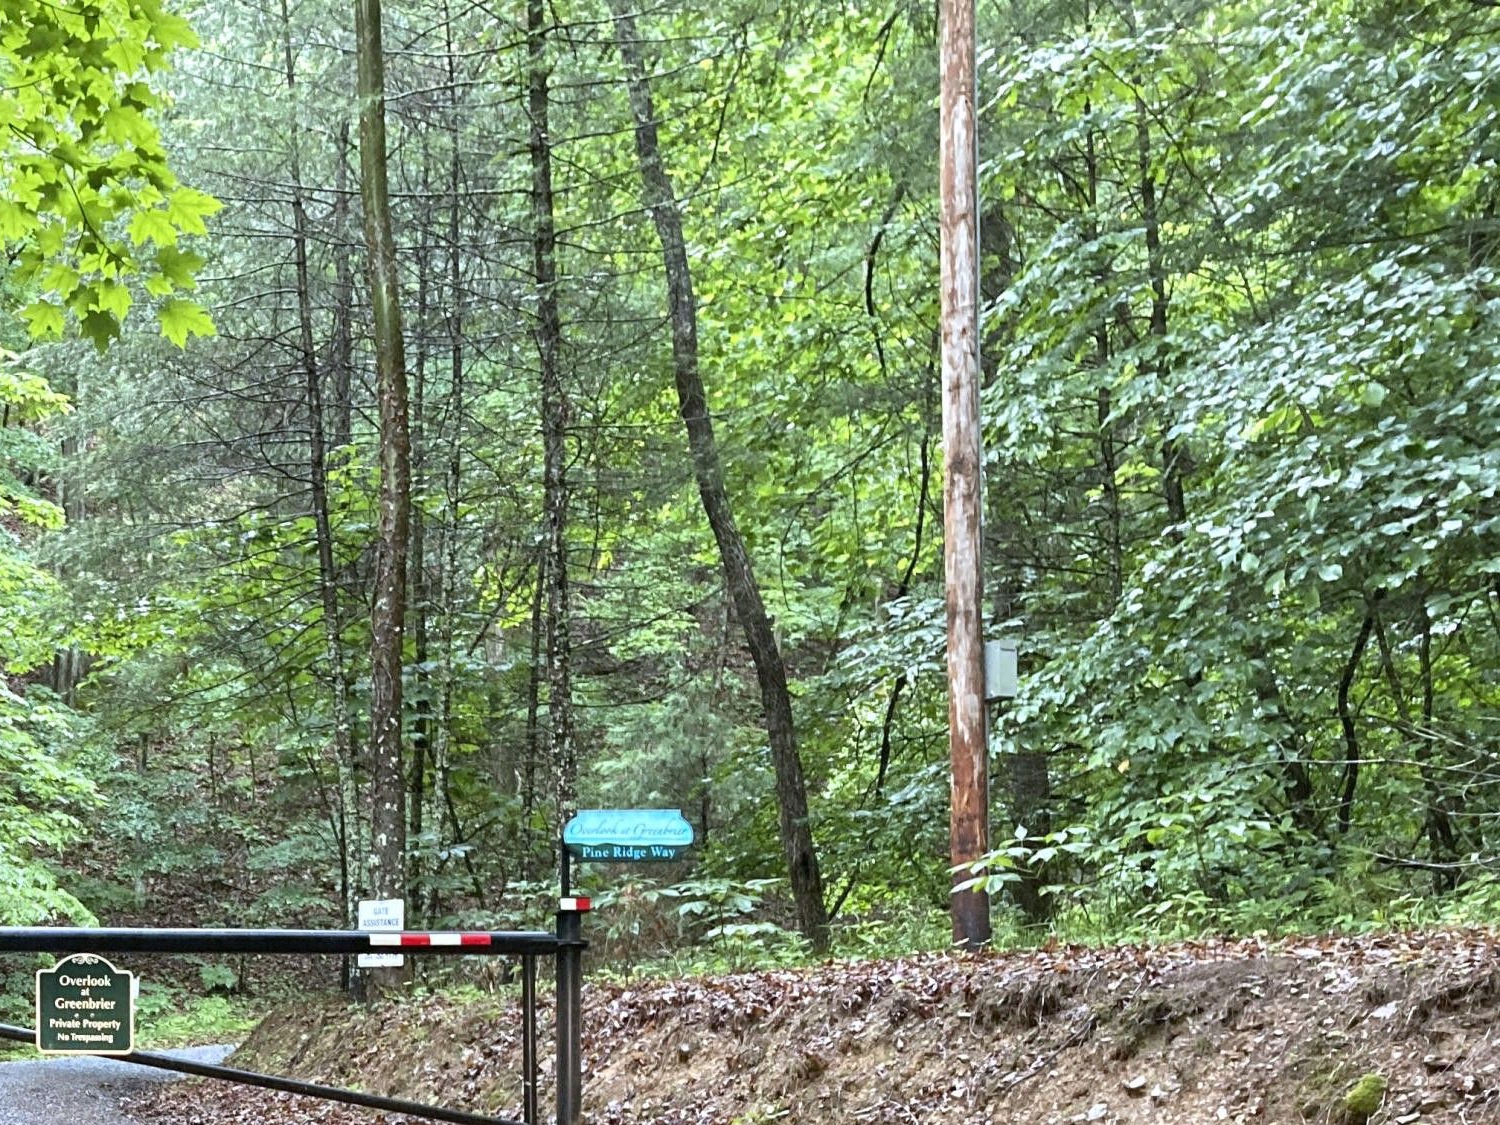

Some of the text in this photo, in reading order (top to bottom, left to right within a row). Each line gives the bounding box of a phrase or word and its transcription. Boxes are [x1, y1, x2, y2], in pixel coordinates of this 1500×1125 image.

[582, 846, 676, 860] Pine Ridge Way
[363, 918, 399, 927] ASSISTANCE
[59, 975, 111, 986] Overlook
[80, 987, 90, 996] at
[54, 998, 116, 1009] Greenbrier
[49, 1018, 121, 1031] Private Property
[57, 1033, 113, 1043] No Trespassing
